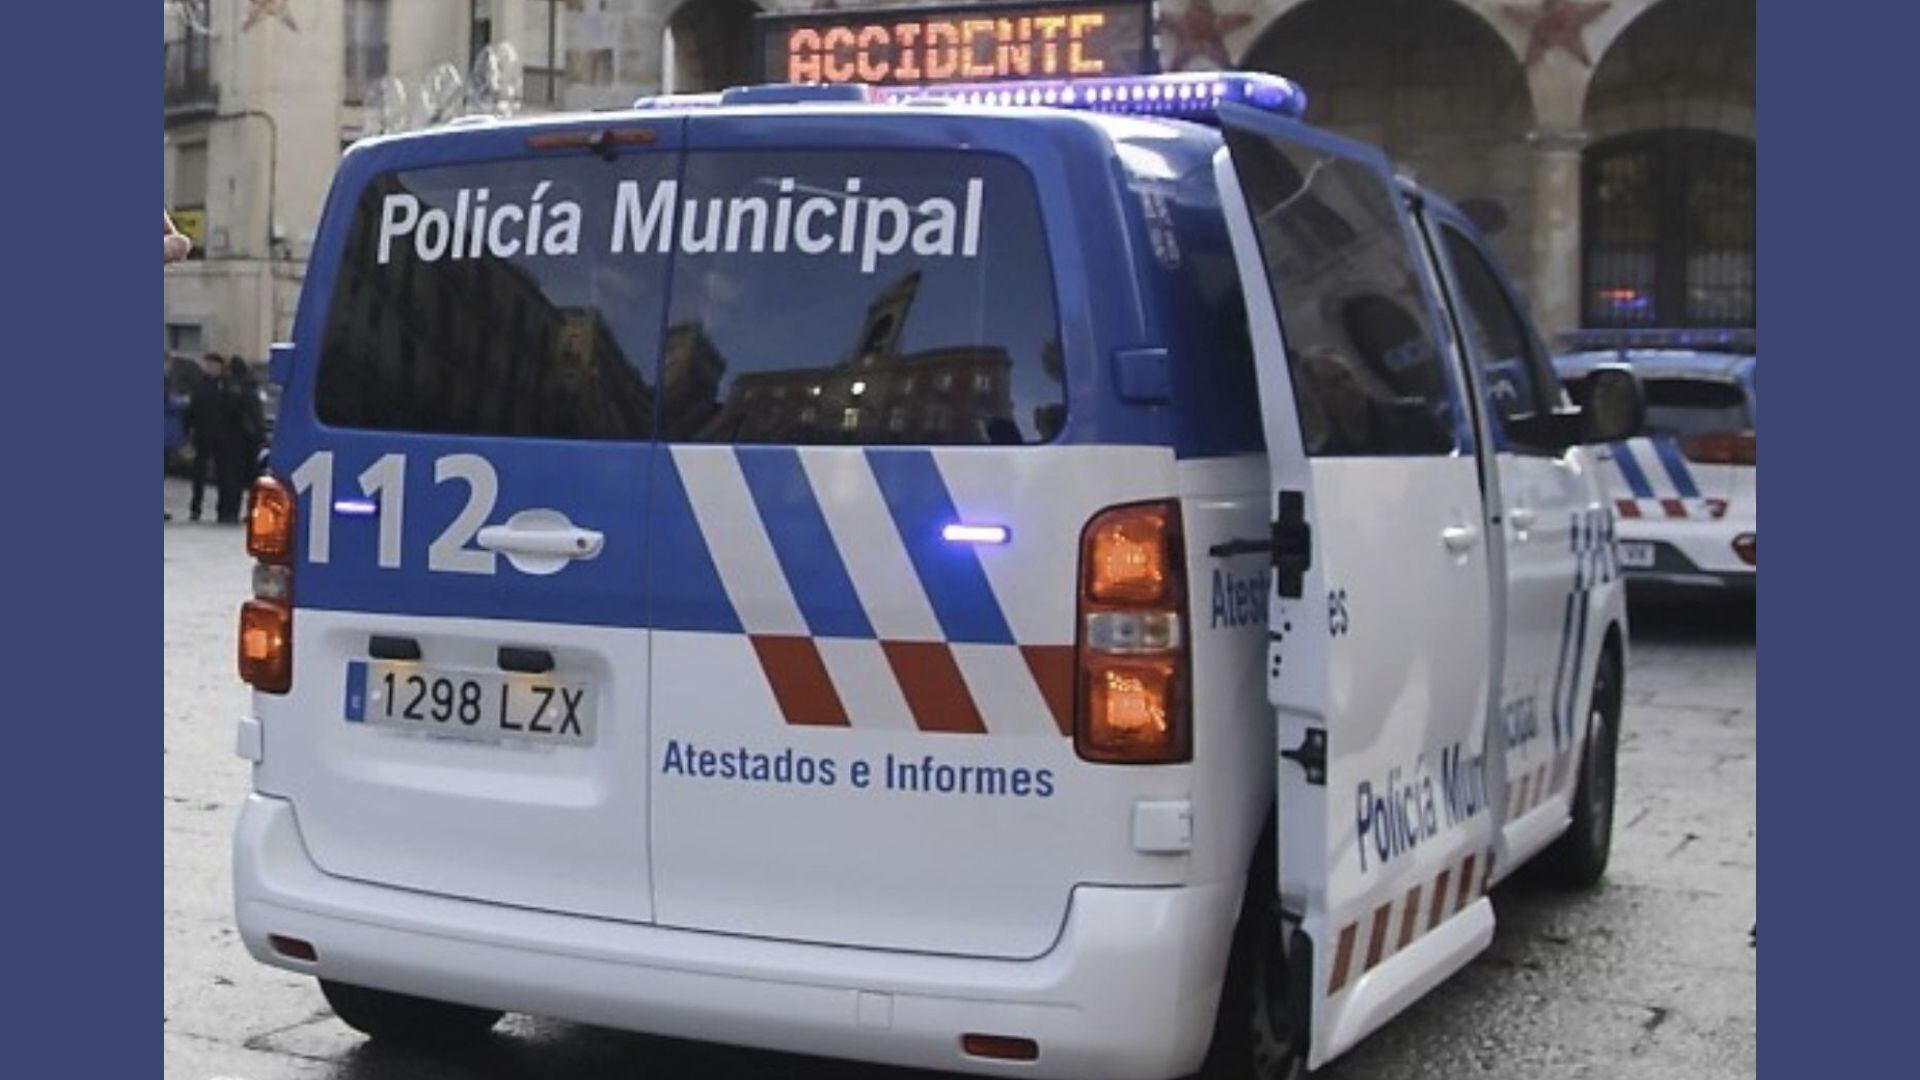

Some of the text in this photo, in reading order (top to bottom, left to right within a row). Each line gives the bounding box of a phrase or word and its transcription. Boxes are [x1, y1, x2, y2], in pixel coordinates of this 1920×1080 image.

[788, 14, 1106, 84] ACCIDENTE
[377, 177, 984, 273] Policía Municipal
[291, 450, 499, 575] 112
[384, 672, 584, 737] 1298 LZX
[661, 739, 1055, 798] Atestados e Informes
[1356, 752, 1438, 874] Policía
